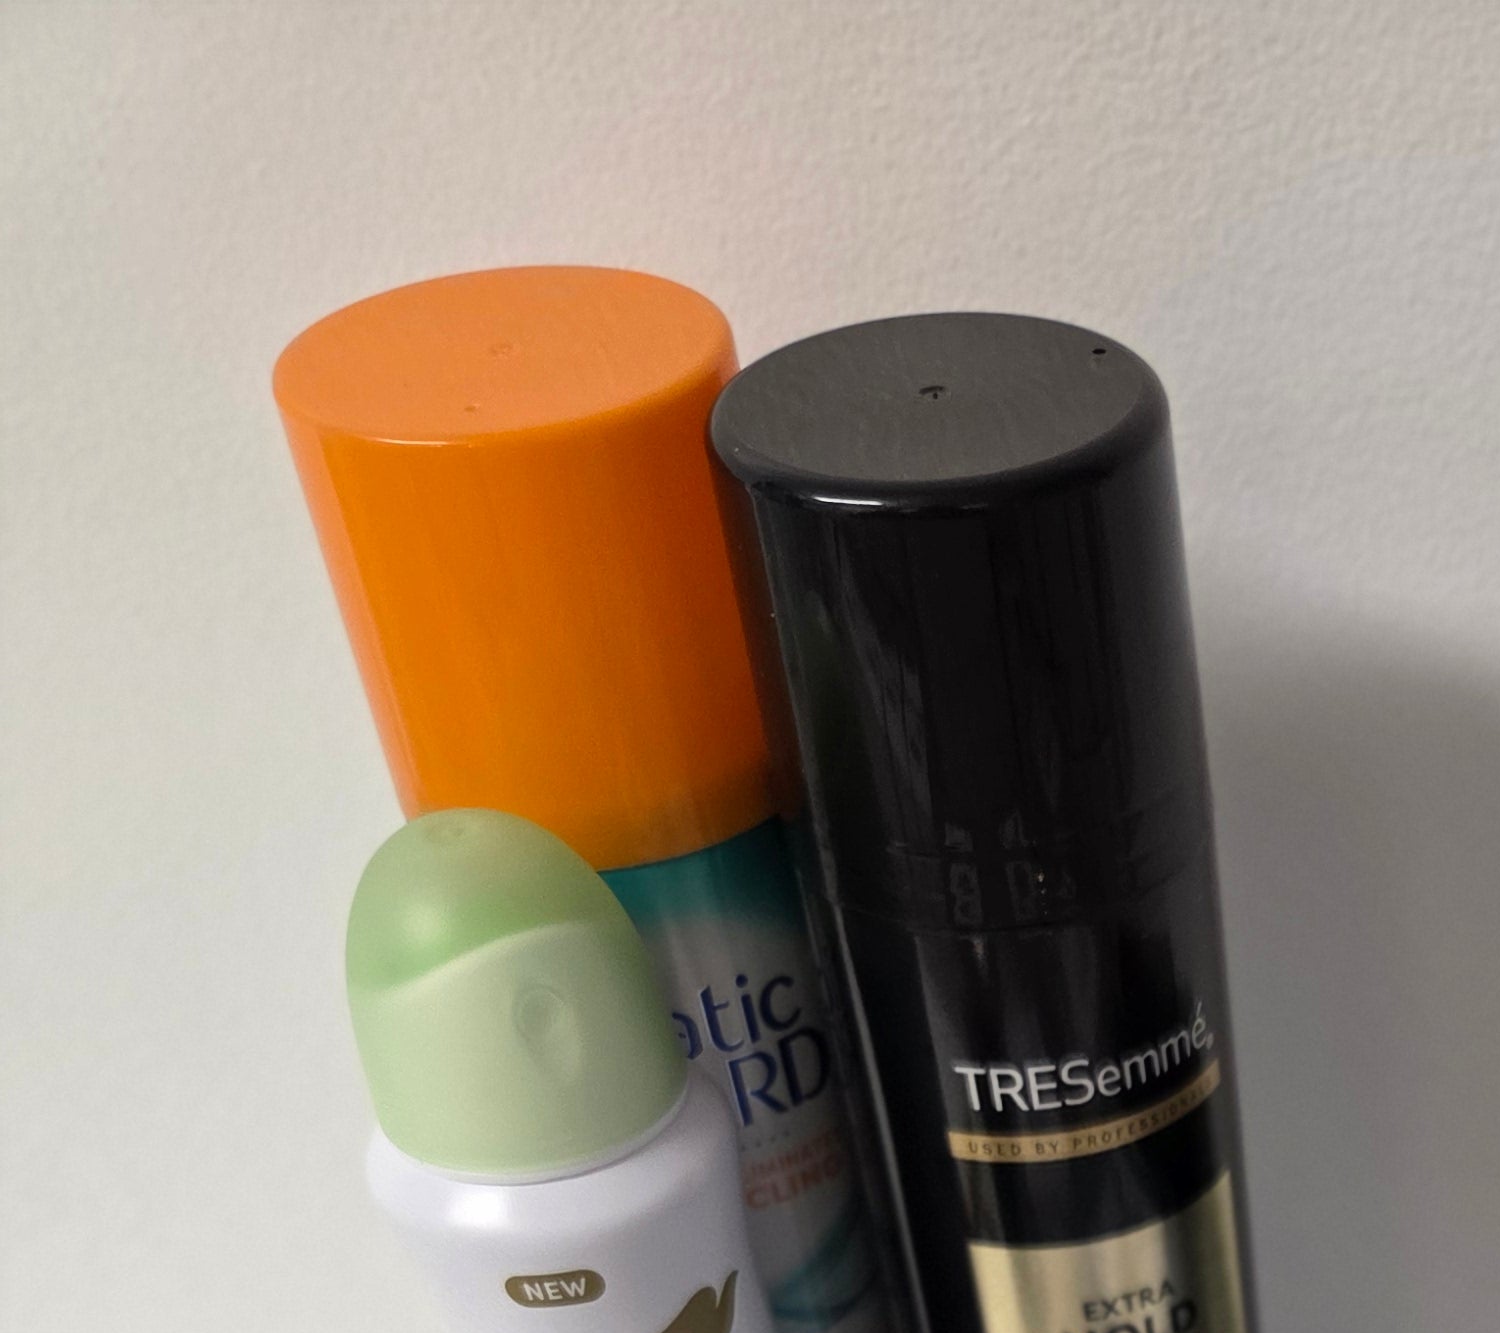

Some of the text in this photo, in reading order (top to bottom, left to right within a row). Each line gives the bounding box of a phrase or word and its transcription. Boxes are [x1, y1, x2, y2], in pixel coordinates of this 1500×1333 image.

[953, 1001, 1208, 1112] TRESemmé
[967, 1141, 1022, 1157] USED
[1034, 1141, 1060, 1156] BY
[523, 1276, 588, 1303] NEW
[1082, 1279, 1176, 1323] EXTRA
